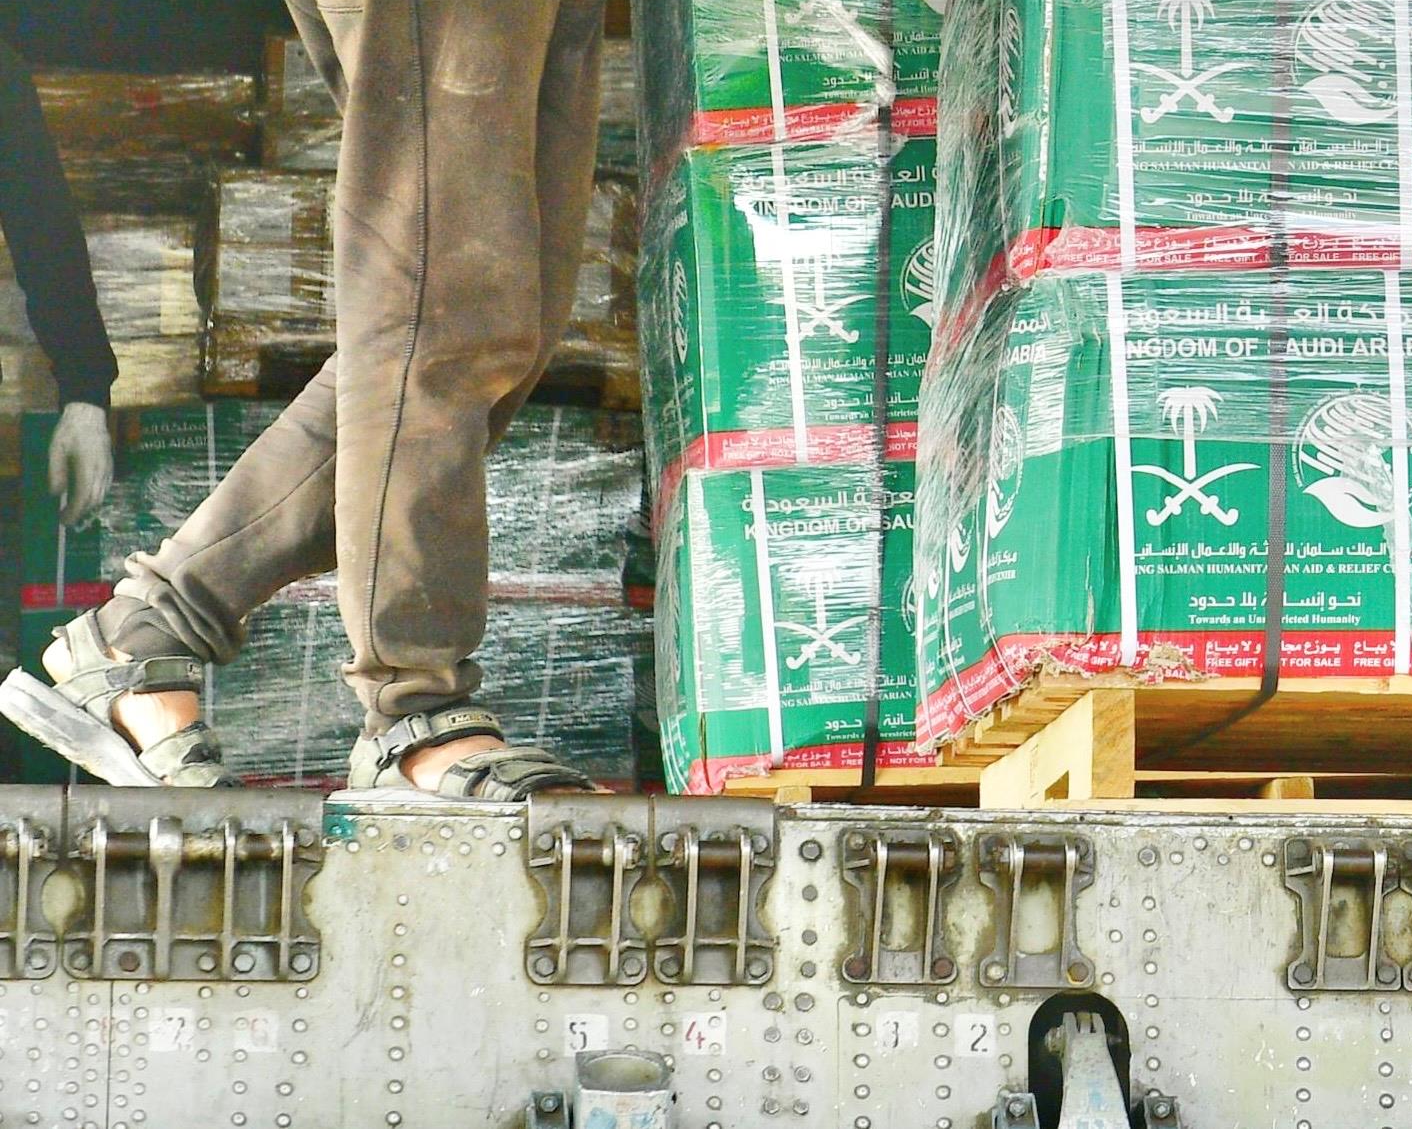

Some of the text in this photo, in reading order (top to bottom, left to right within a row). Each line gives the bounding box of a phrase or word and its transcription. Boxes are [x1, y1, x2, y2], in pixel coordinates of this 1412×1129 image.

[890, 190, 936, 209] AUD
[1127, 337, 1217, 360] NGDOM
[1225, 337, 1258, 358] OF
[1286, 337, 1345, 359] AUDI
[744, 521, 840, 540] KNGDOM
[883, 513, 915, 531] SAU
[1136, 564, 1155, 575] ING
[1157, 563, 1204, 574] SALMAN
[1303, 563, 1323, 574] AID
[1326, 564, 1336, 574] &
[1338, 563, 1381, 574] RELIEF
[1188, 614, 1361, 626] Towards an Humanity
[1206, 657, 1232, 667] FREE
[1290, 658, 1313, 667] FOR
[1314, 658, 1341, 667] SALE
[1353, 657, 1380, 667] FREE
[569, 1021, 706, 1051] 5 4
[970, 1023, 989, 1053] 2
